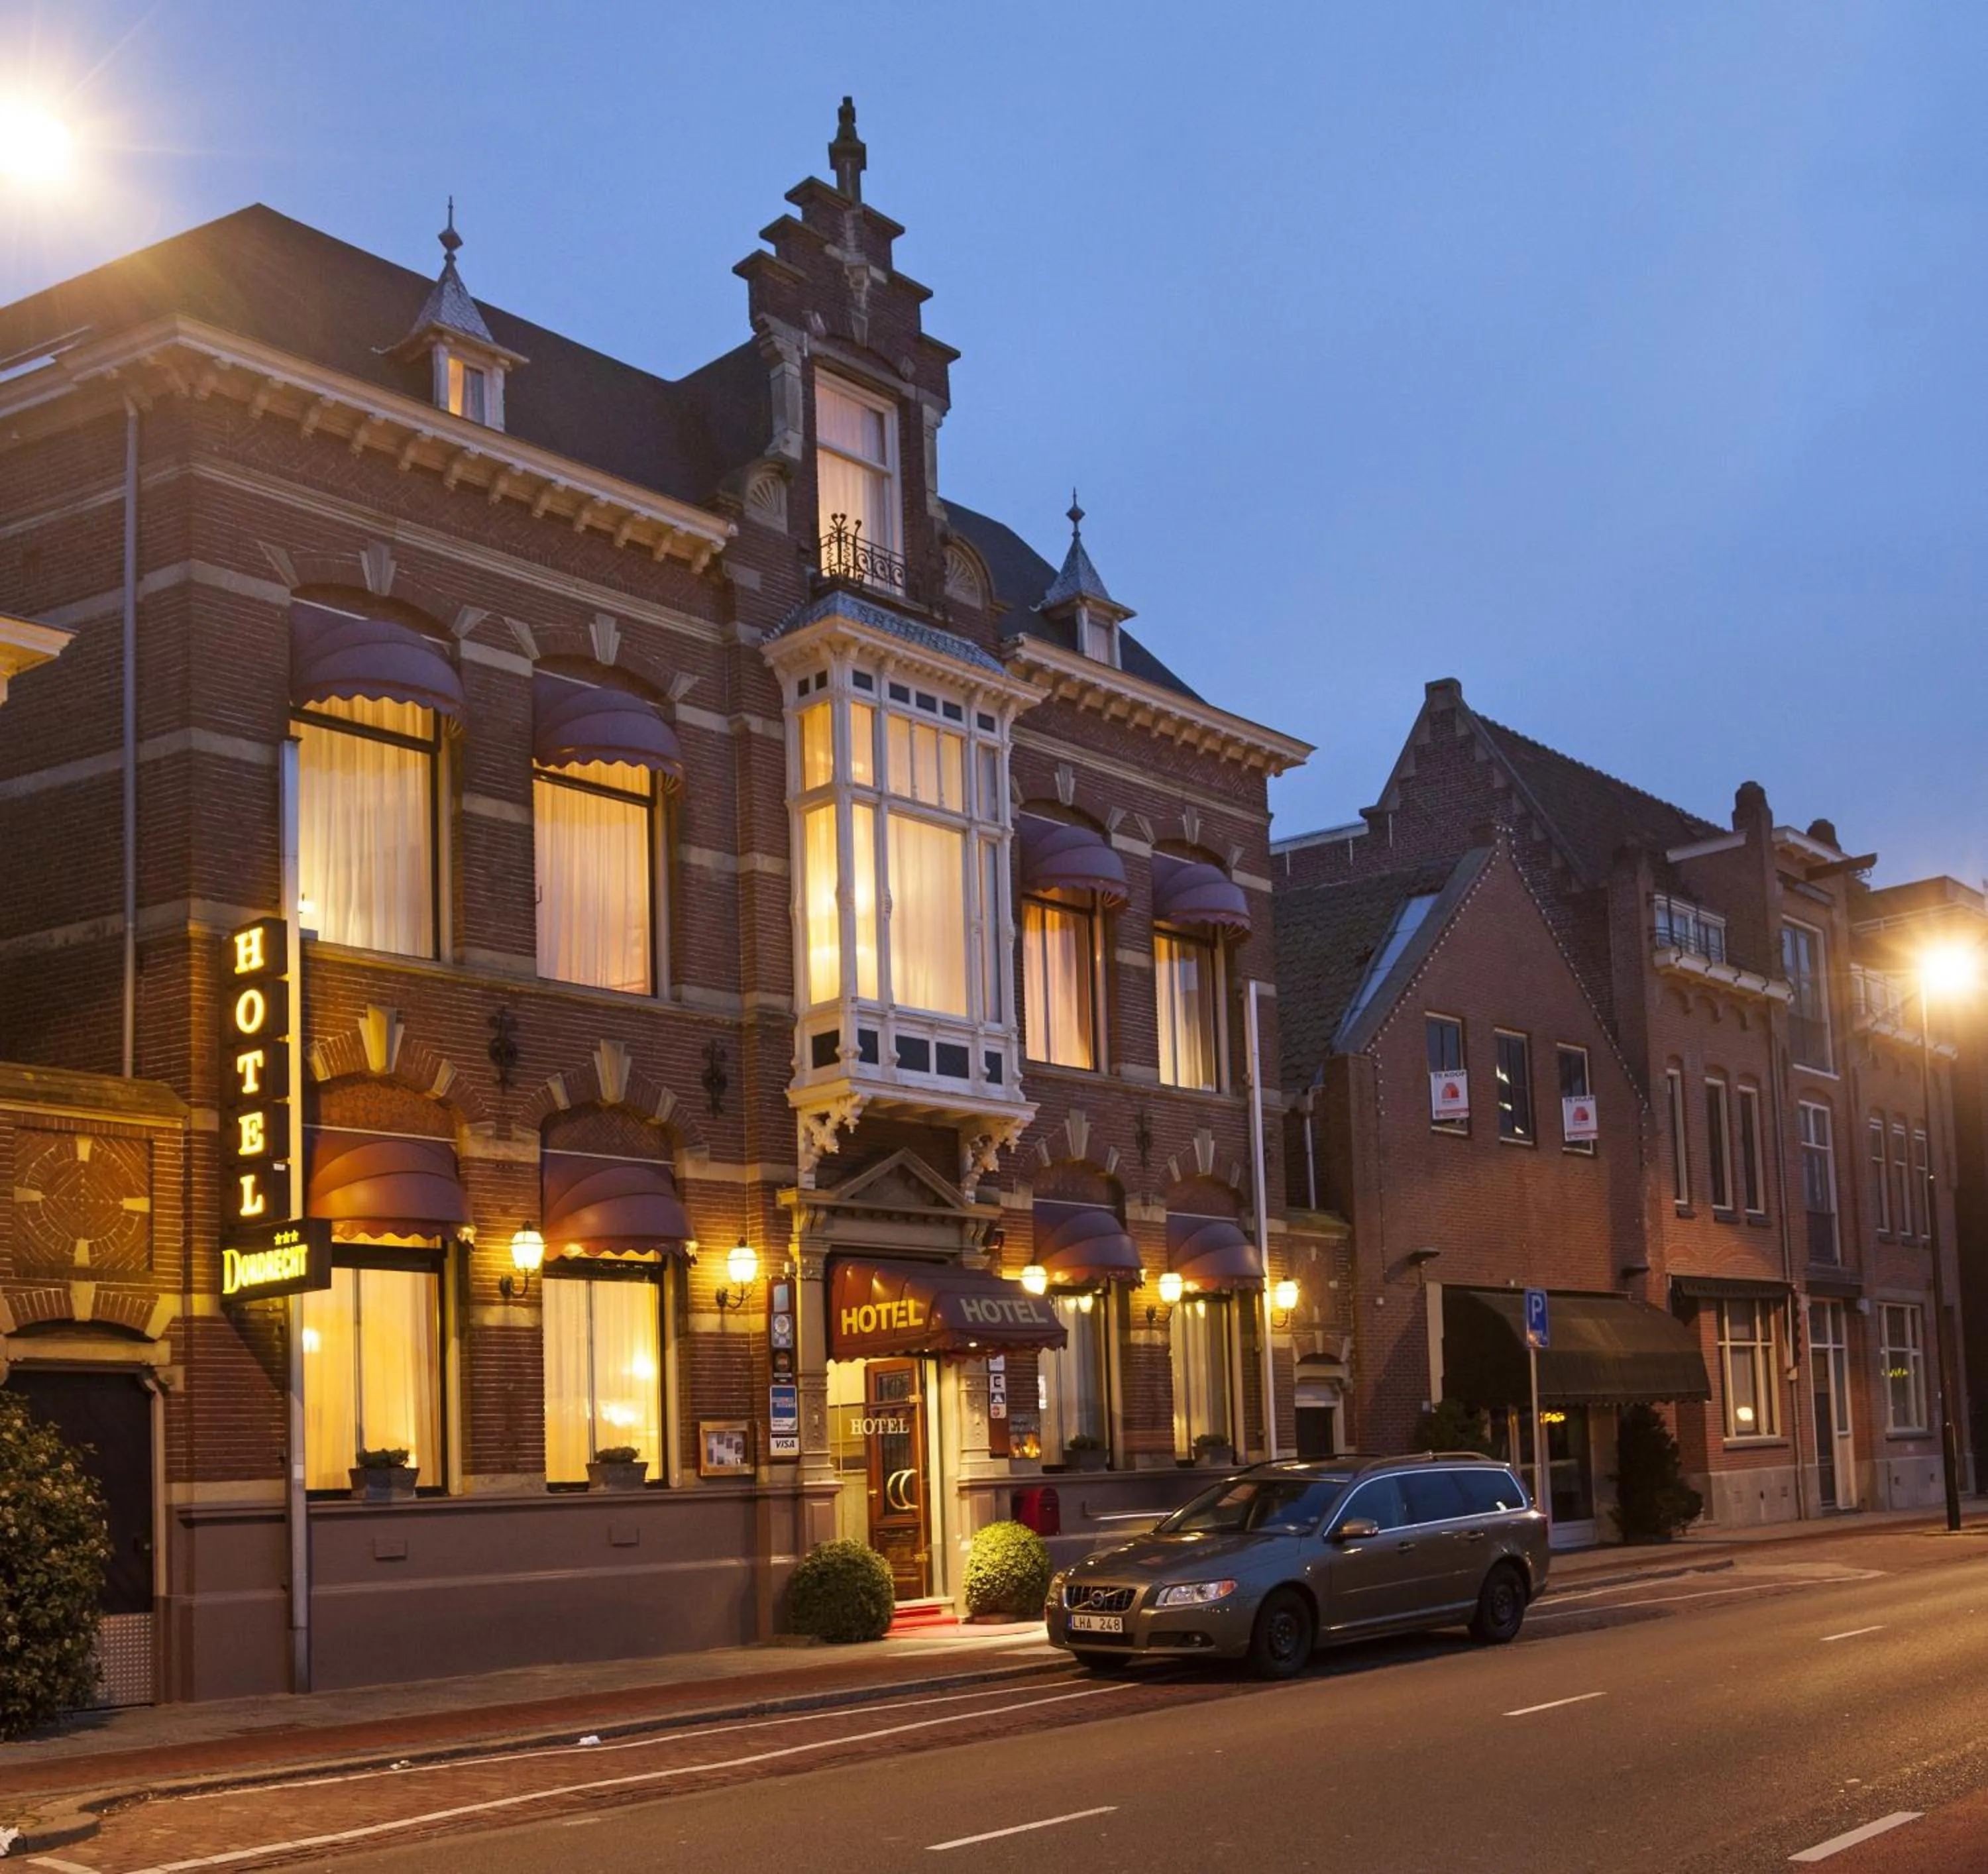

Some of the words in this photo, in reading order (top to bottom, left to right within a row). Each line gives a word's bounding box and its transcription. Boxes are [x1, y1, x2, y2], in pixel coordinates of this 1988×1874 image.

[234, 927, 264, 1217] HOTEL
[841, 1299, 924, 1335] HOTEL
[960, 1298, 1048, 1324] HOTEL
[1531, 1295, 1543, 1323] P
[850, 1417, 910, 1435] HOTEL
[775, 1439, 795, 1449] VISA
[1074, 1618, 1092, 1629] LHA
[1099, 1618, 1121, 1631] 248
